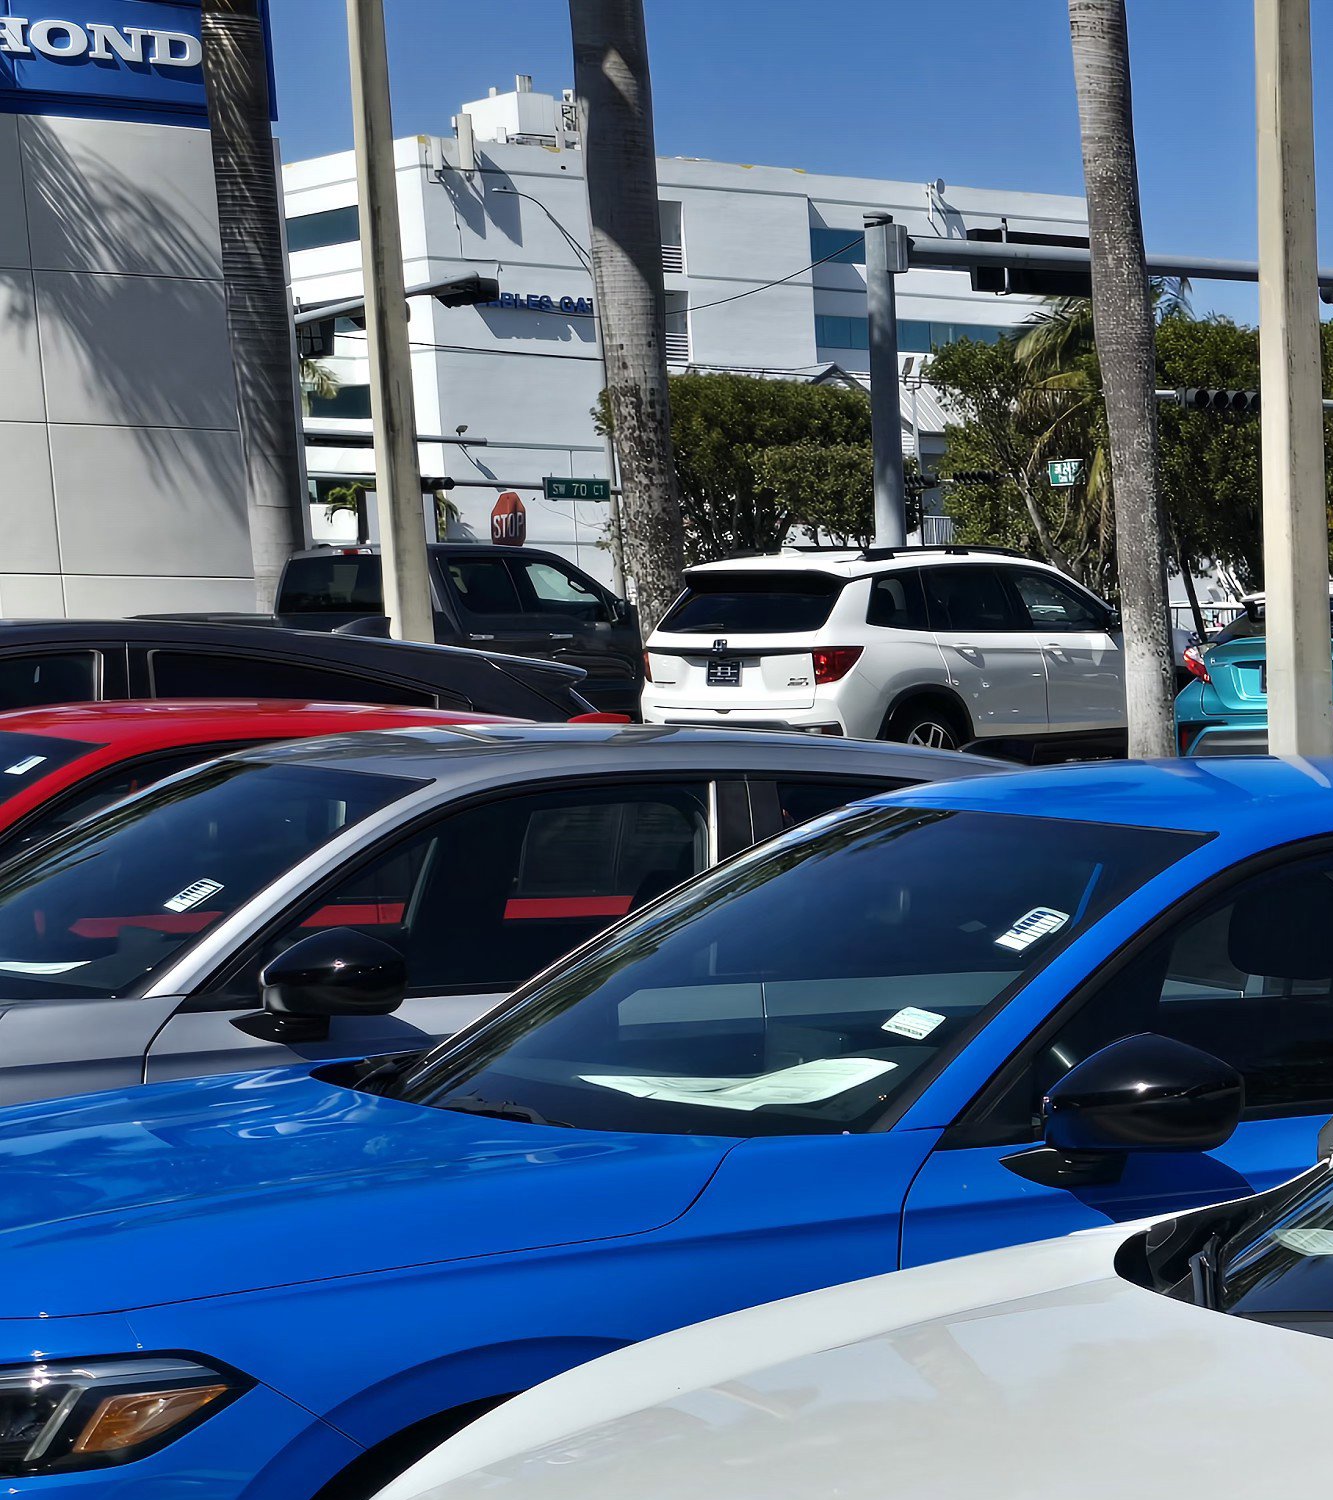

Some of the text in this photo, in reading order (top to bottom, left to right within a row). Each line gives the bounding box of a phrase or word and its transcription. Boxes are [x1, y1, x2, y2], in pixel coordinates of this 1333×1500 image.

[552, 484, 565, 494] SW
[572, 484, 587, 496] 70
[493, 512, 524, 539] STOP
